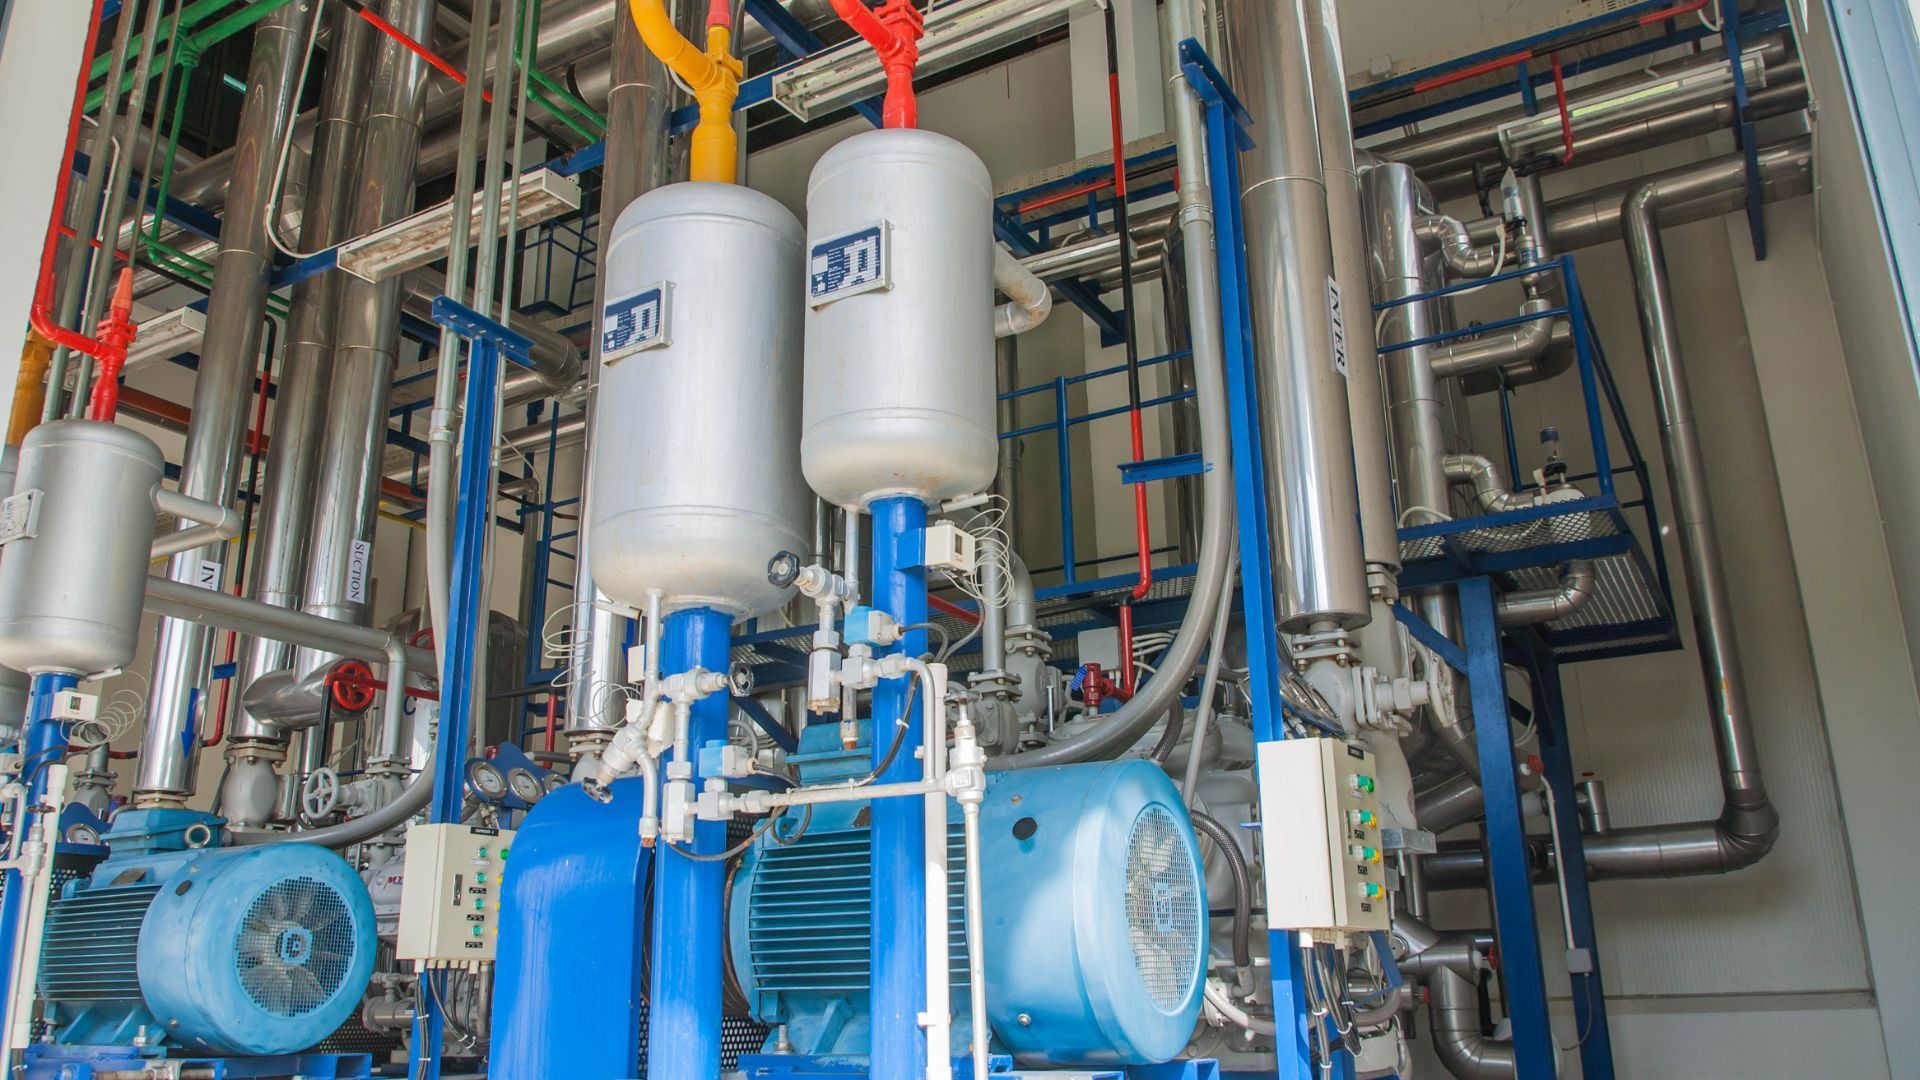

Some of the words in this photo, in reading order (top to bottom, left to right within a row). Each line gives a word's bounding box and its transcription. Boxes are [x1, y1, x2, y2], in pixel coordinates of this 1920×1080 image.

[1330, 286, 1345, 368] INTER
[200, 565, 215, 590] IN
[350, 542, 365, 600] SUCTION
